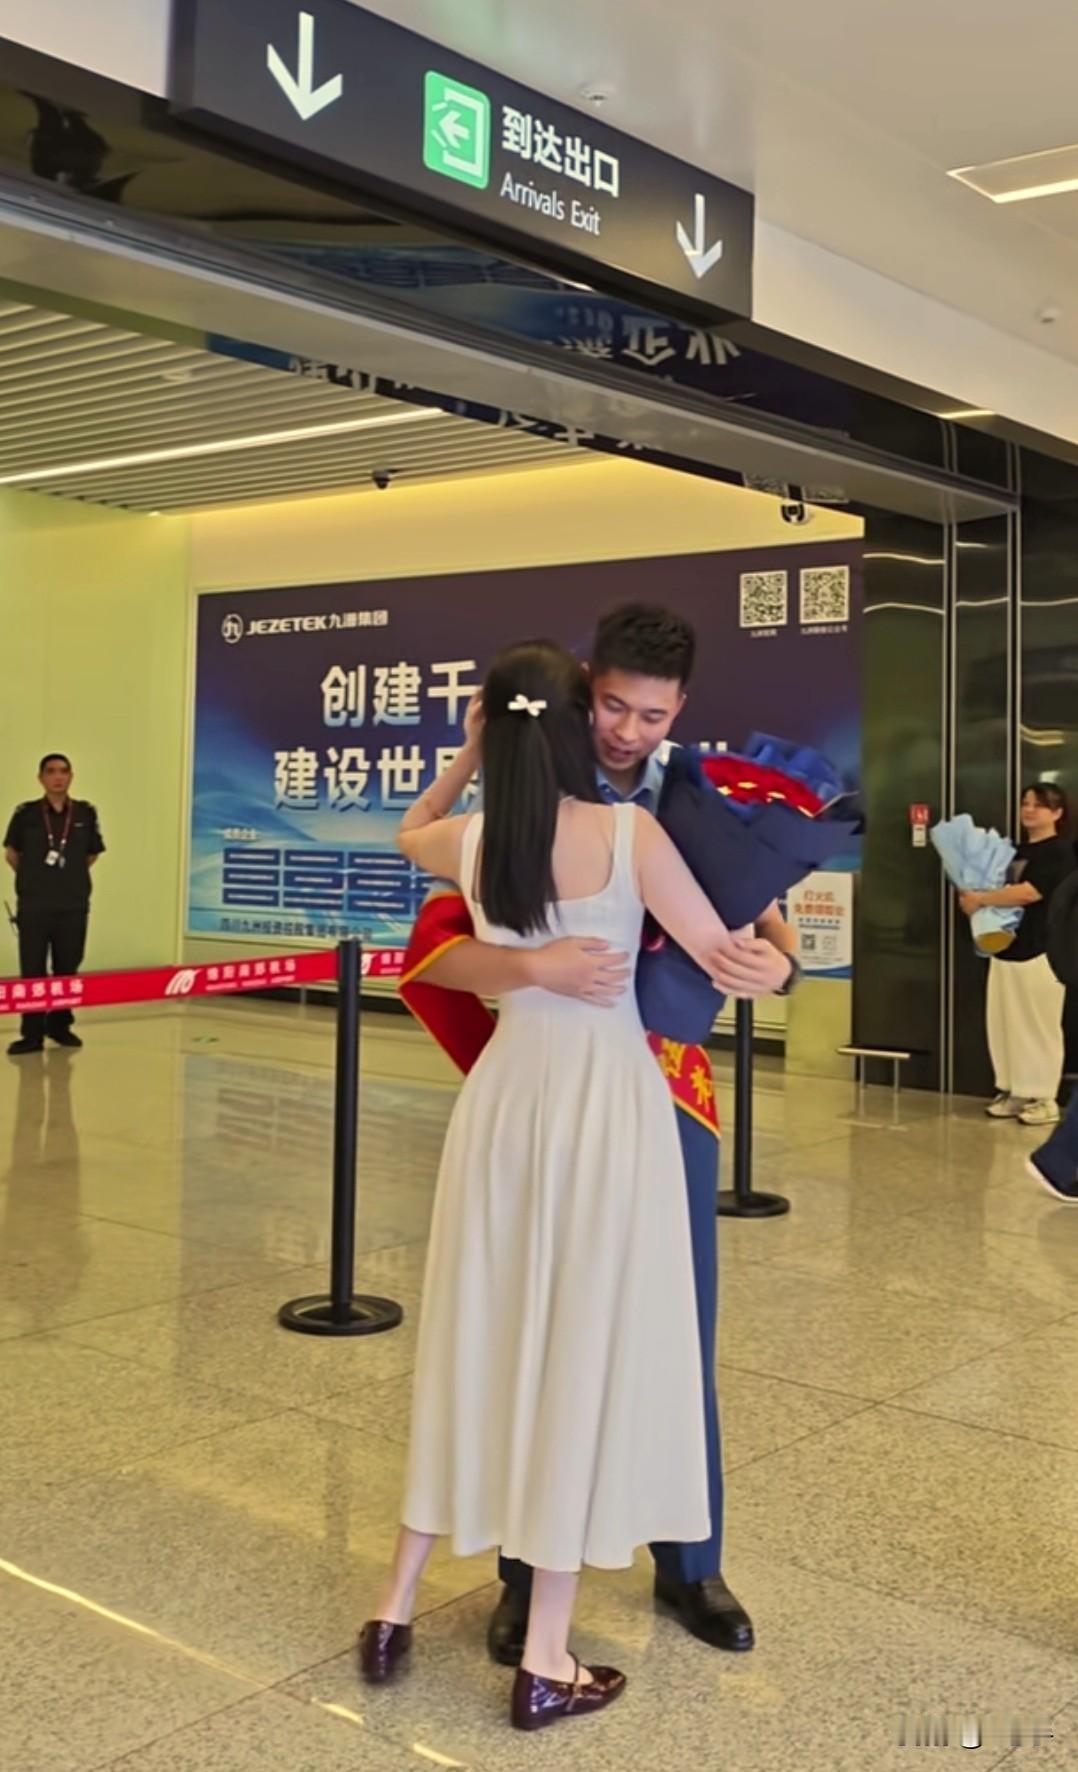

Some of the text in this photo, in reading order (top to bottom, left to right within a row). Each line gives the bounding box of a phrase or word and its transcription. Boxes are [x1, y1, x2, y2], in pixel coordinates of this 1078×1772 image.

[501, 105, 620, 198] 到达出口
[501, 174, 601, 236] Arrivals Exit
[246, 616, 327, 637] JEZETEK
[321, 660, 481, 728] 创建千
